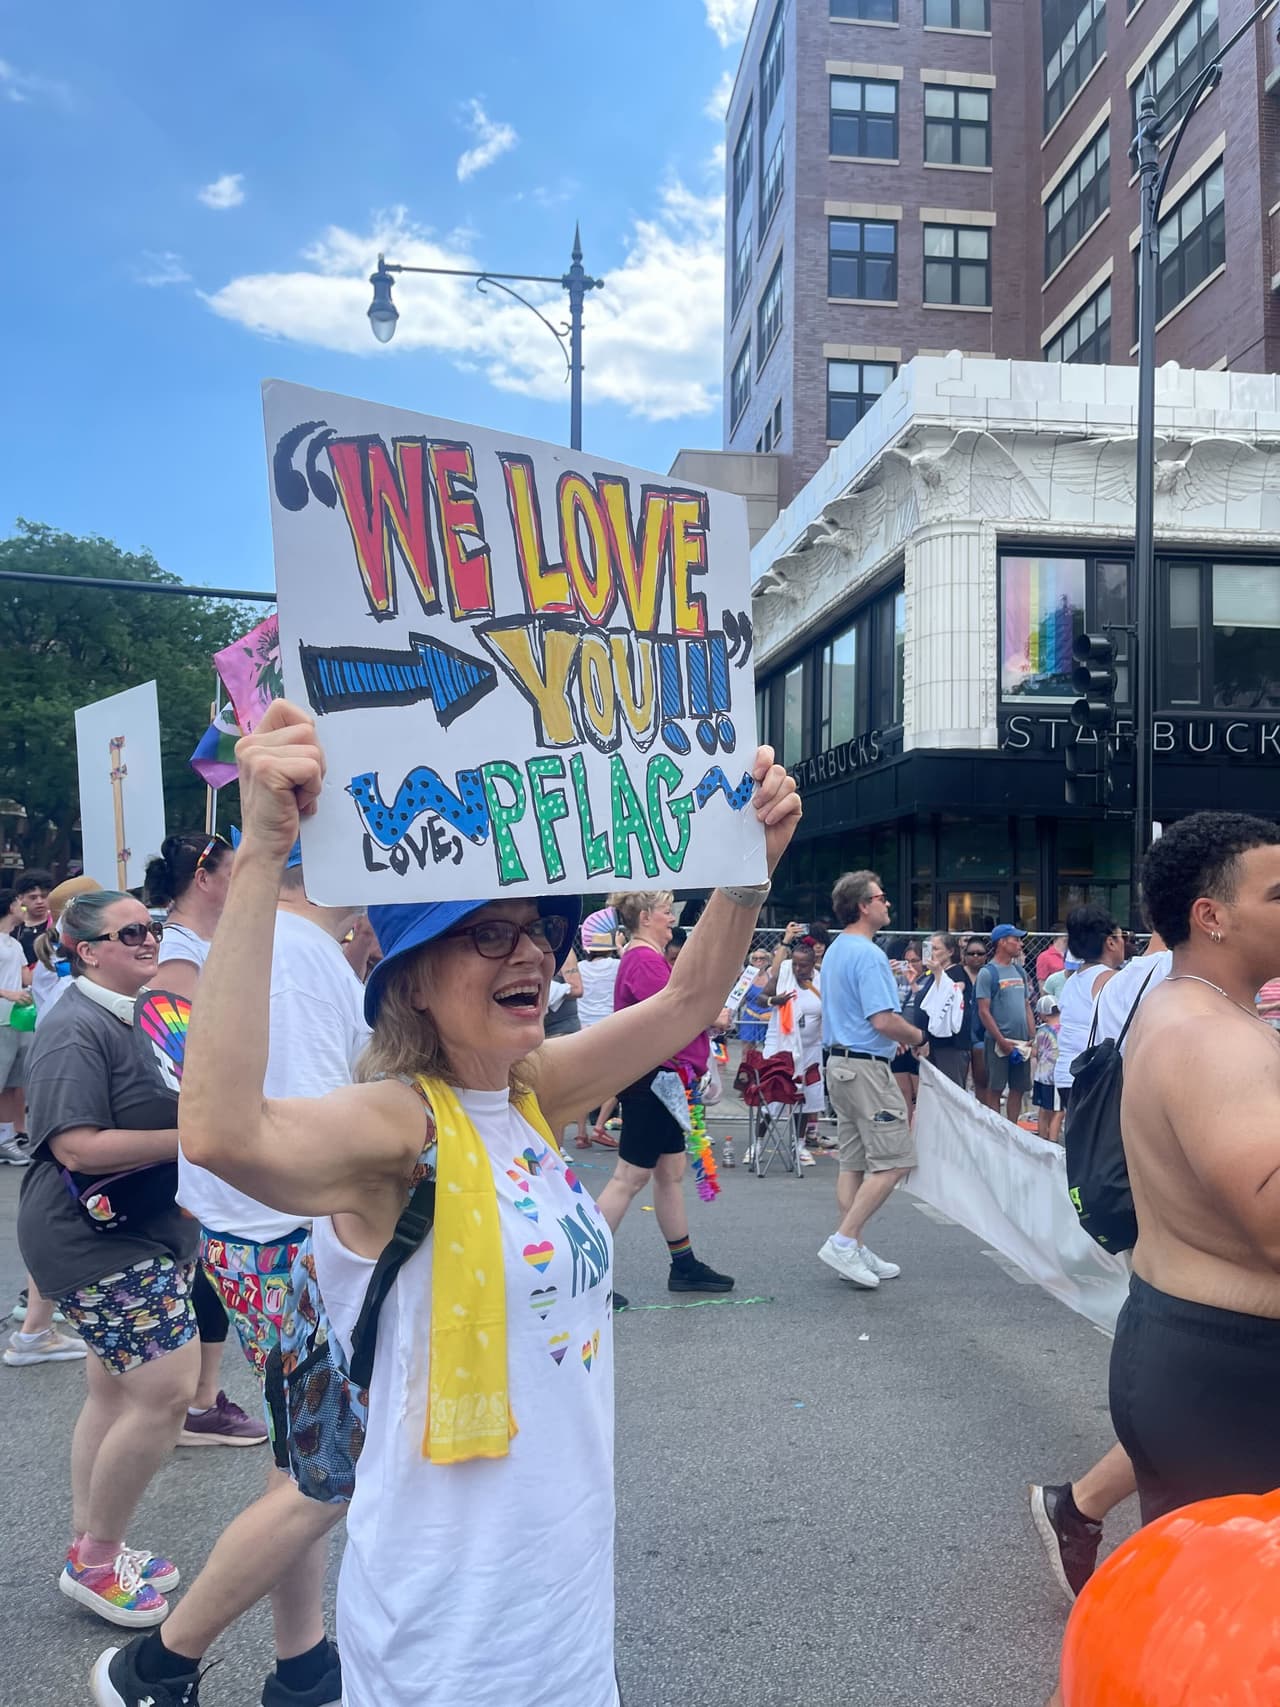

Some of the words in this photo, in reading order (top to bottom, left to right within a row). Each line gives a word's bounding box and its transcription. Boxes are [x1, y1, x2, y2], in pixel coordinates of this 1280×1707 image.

[495, 450, 711, 637] LOVE
[363, 814, 464, 876] LOVE,
[482, 751, 696, 886] PFLAG
[793, 730, 880, 790] STARBUCKS
